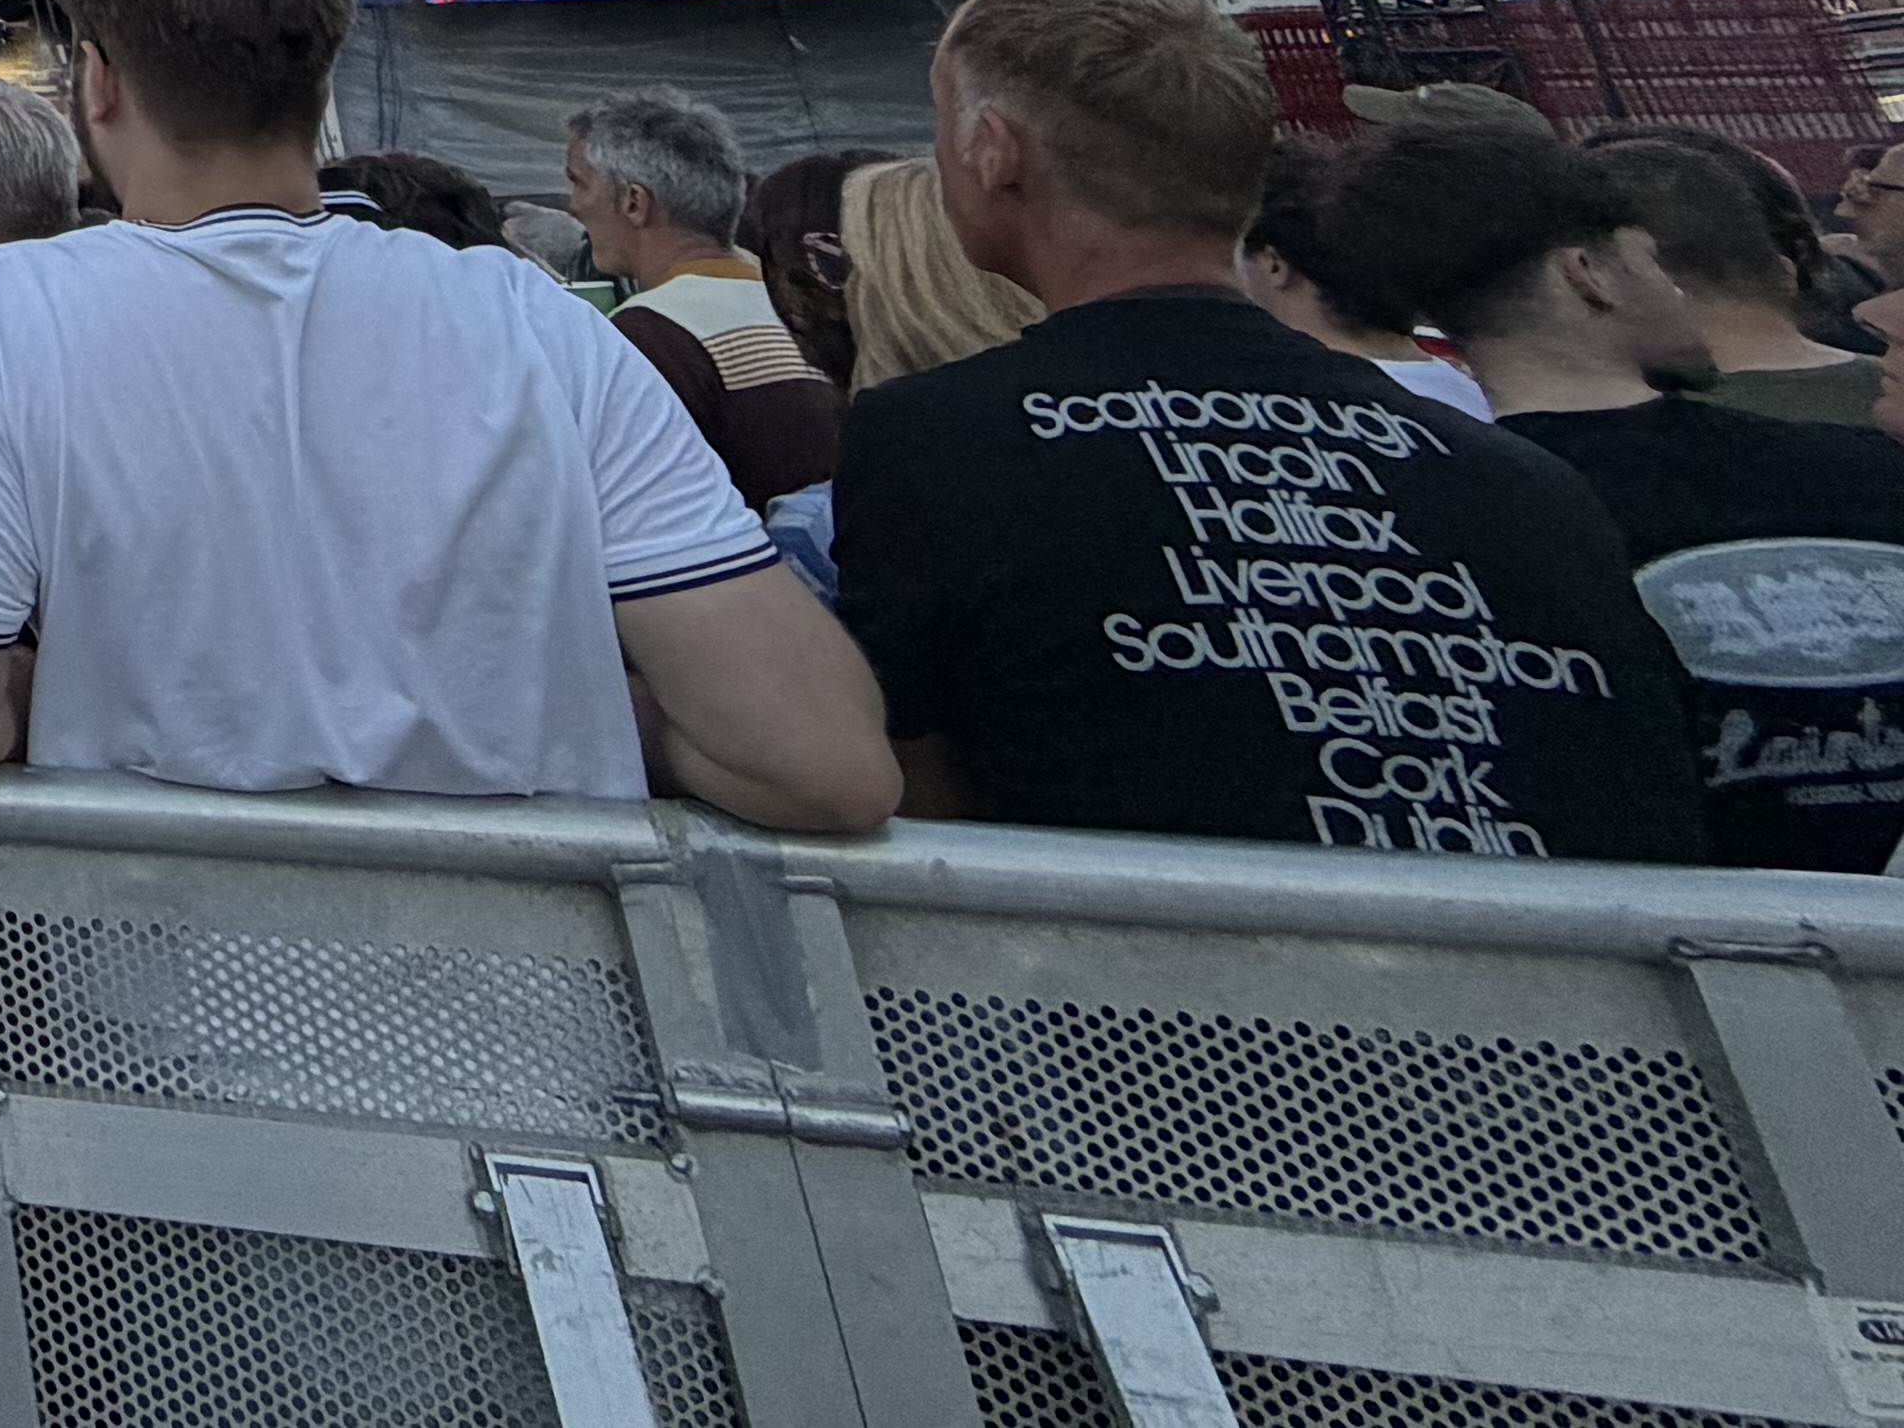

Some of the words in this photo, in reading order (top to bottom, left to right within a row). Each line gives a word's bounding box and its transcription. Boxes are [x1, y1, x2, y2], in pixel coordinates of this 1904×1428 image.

[1023, 380, 1452, 459] Scarborough
[1138, 430, 1387, 496] Lincoln
[1175, 486, 1420, 555] Halifax
[1162, 545, 1492, 622] Liverpool
[1103, 608, 1614, 699] Southampton
[1266, 671, 1504, 746] Belfast
[1318, 738, 1512, 809] Cork
[1305, 796, 1550, 858] Dublin
